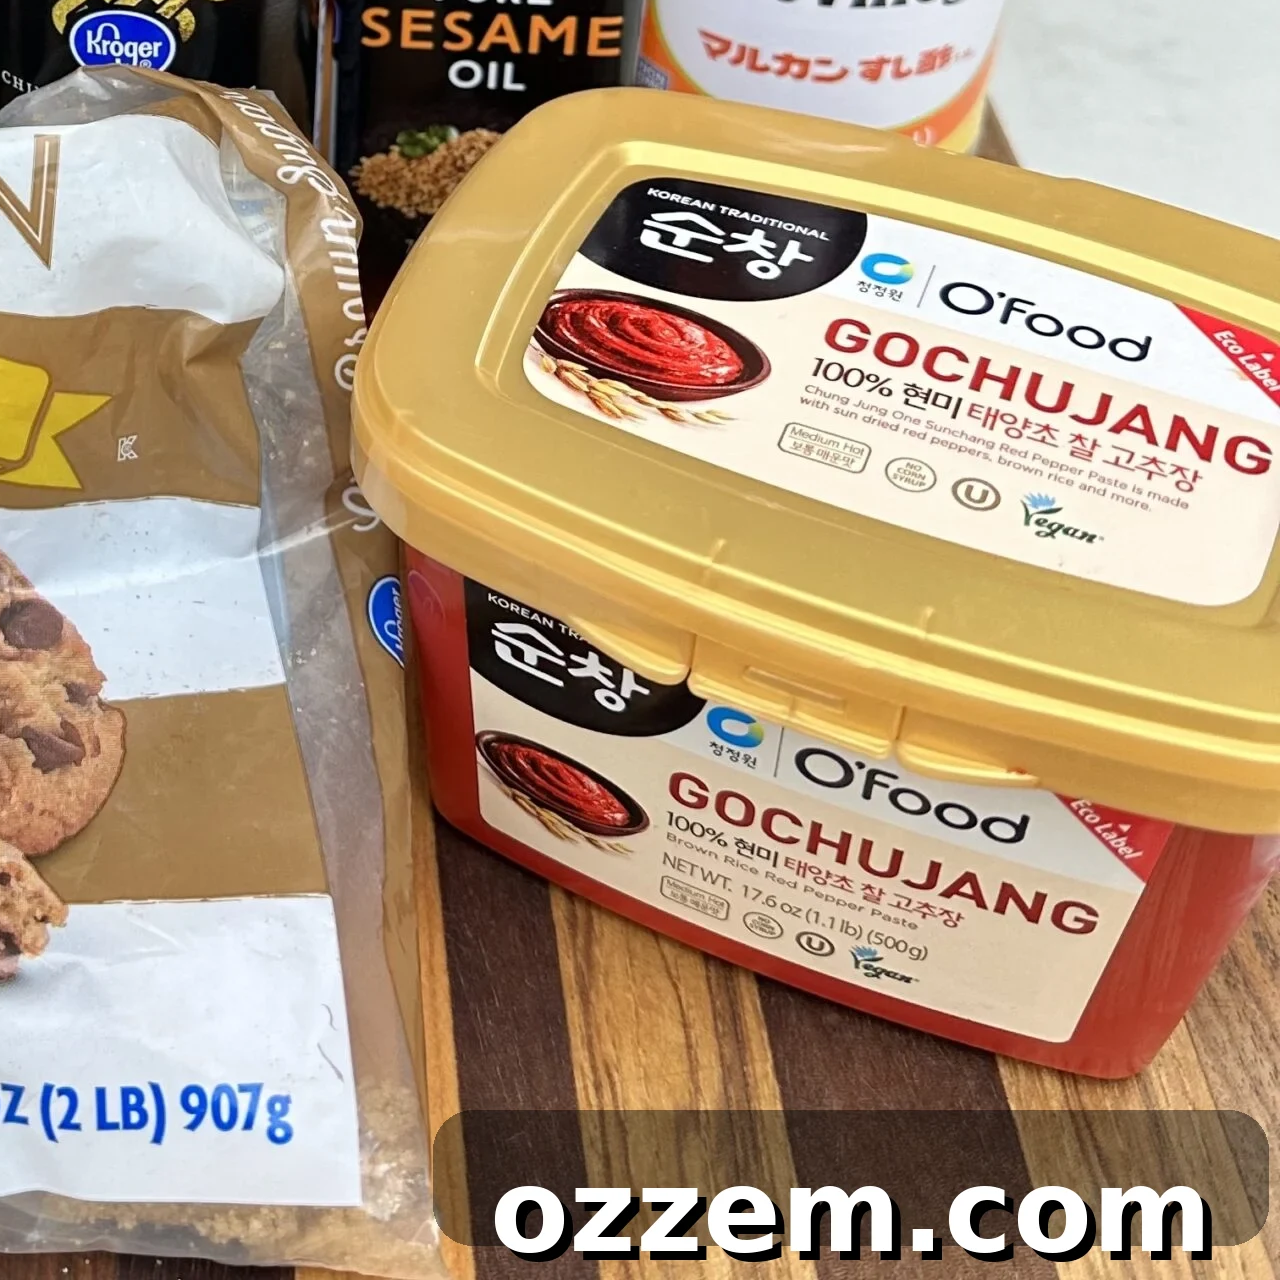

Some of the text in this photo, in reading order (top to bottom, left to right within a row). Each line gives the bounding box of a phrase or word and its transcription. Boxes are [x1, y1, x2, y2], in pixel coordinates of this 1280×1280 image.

[85, 21, 163, 66] Kroger
[361, 6, 624, 58] SESAME
[697, 27, 850, 84] マルカン
[448, 59, 527, 92] OIL
[639, 210, 815, 280] 순창
[647, 187, 831, 242] KOREAN TRADITIONAL
[856, 278, 904, 304] 청정원
[939, 281, 1153, 363] O'Food
[1213, 329, 1280, 392] Eco Label
[811, 357, 1204, 493] 100% 현미 태양초 찰 고추장
[823, 317, 1274, 476] GOCHUJANG
[790, 426, 865, 456] Medium Hot
[799, 396, 1153, 512] with sun dried red peppers, brown rice and more.
[804, 384, 1190, 510] Chung Jung One Sunchang Red Pepper Paste is made
[906, 462, 922, 472] NO
[892, 473, 927, 488] SYRUP
[897, 467, 926, 481] CORN
[1020, 496, 1097, 544] Vegan
[487, 592, 554, 629] KOREAN
[491, 622, 650, 713] 순창
[708, 741, 757, 770] 청정원
[794, 747, 1030, 844] O'Food
[669, 772, 1100, 935] GOCHUJANG
[1071, 798, 1144, 860] Eco Label
[666, 810, 728, 848] 100%
[734, 837, 779, 868] 현미
[784, 856, 854, 894] 태양초
[888, 893, 965, 928] 고추장
[666, 832, 919, 930] Brown Rice Red Pepper Paste
[742, 884, 778, 908] 17.6
[780, 902, 803, 919] oz
[867, 929, 928, 961] (500g)
[40, 1082, 82, 1144] (2
[96, 1082, 166, 1145] LB)
[181, 1082, 294, 1145] 907g
